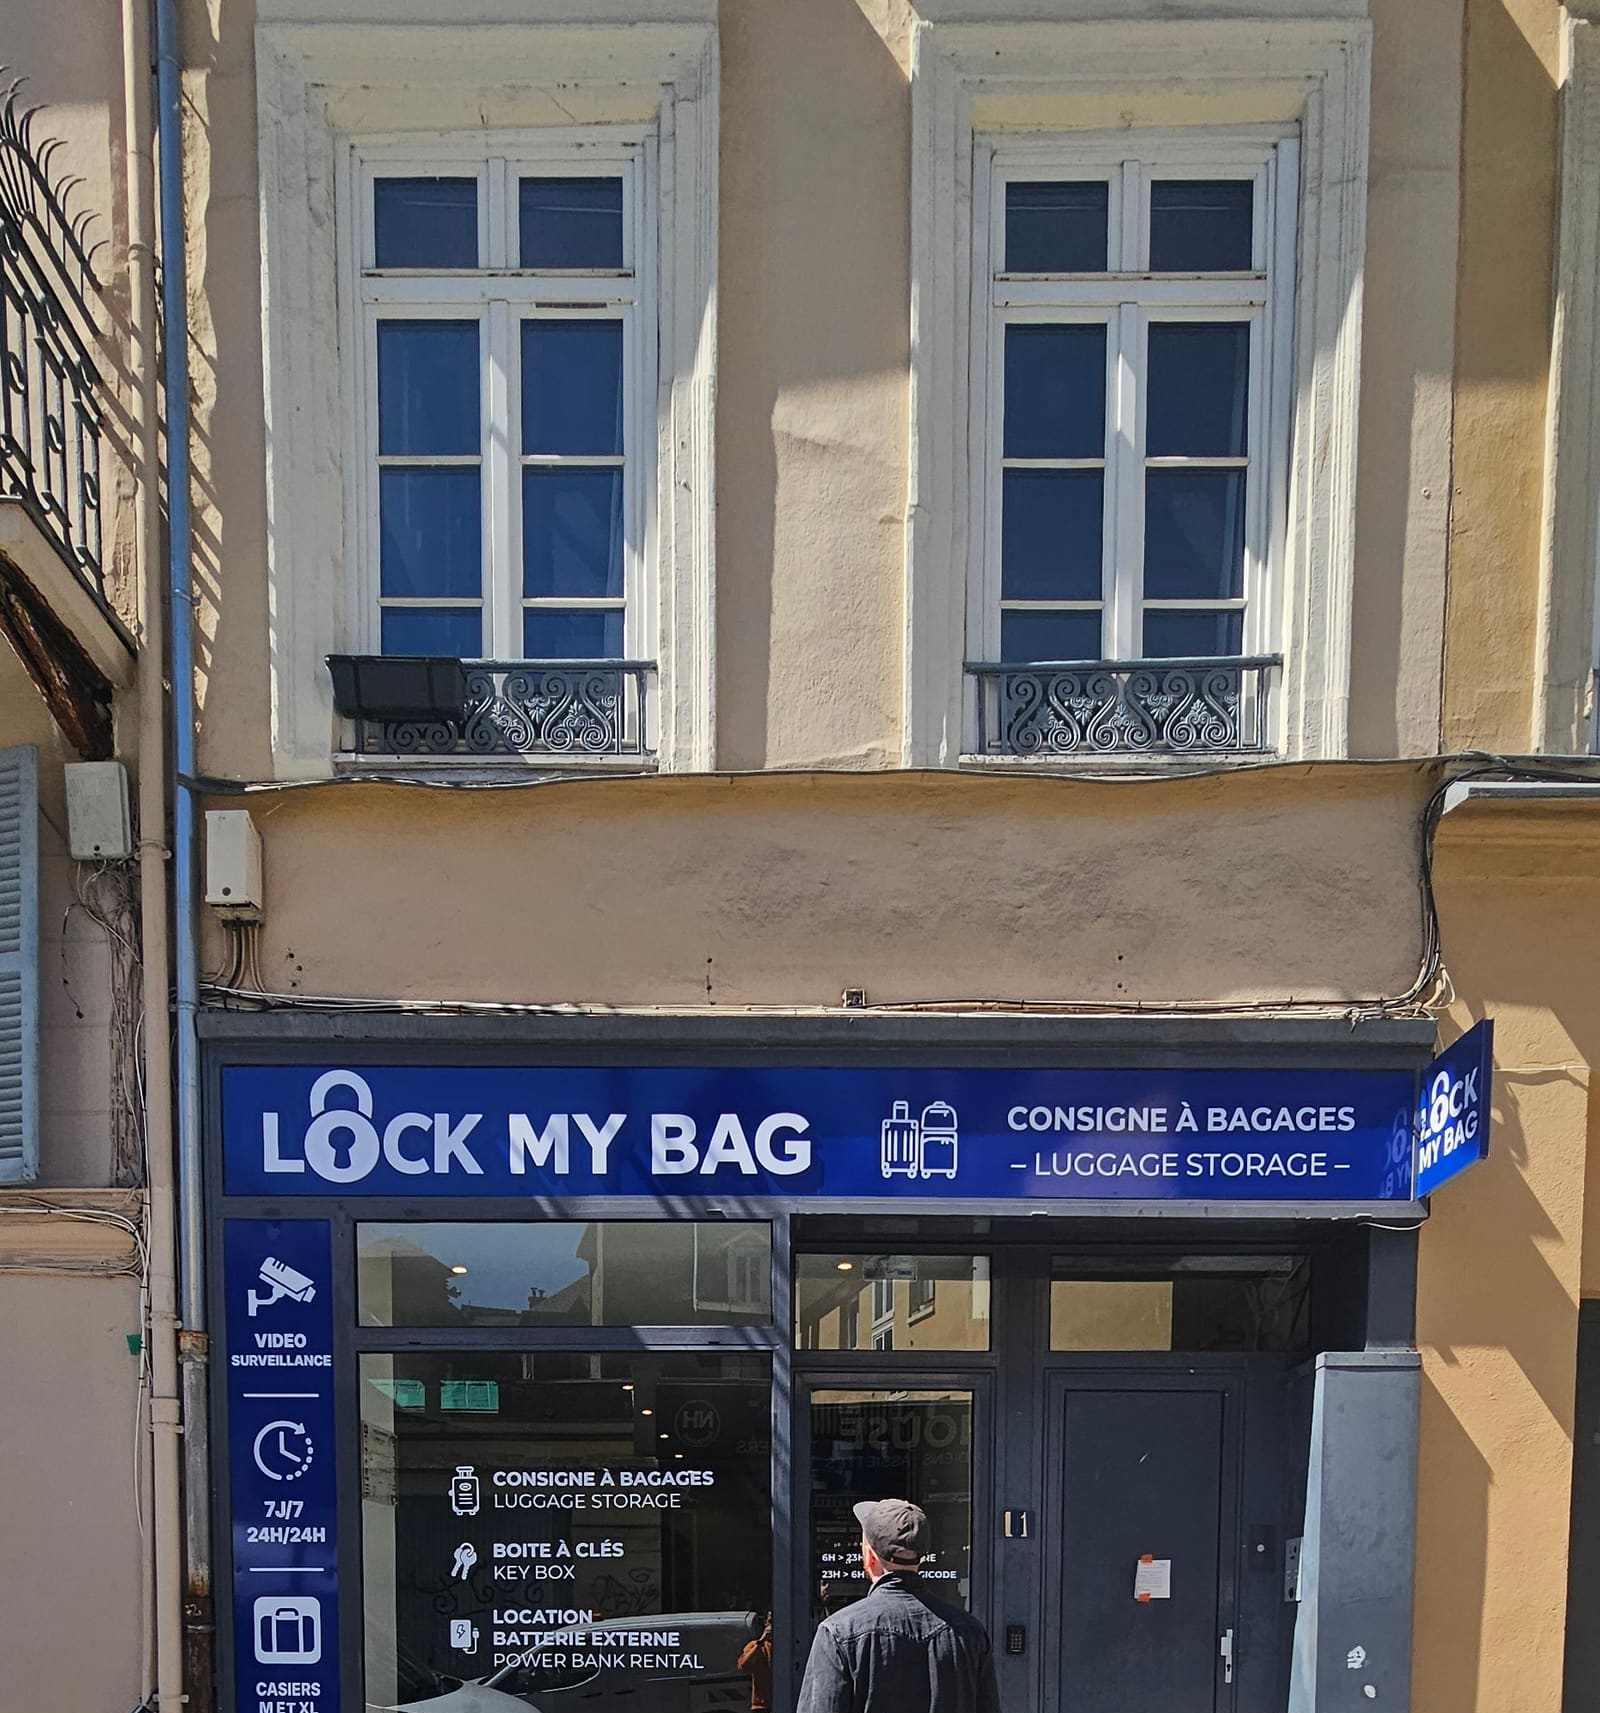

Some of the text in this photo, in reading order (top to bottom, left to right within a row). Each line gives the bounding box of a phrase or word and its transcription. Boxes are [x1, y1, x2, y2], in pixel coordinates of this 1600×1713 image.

[1420, 1066, 1478, 1142] LOCK
[1007, 1101, 1355, 1133] CONSIGNE À BAGAGES
[263, 1070, 812, 1184] LOCK MY BAG
[1418, 1110, 1478, 1174] MY BAG
[1035, 1152, 1179, 1177] LUGGAGE
[1186, 1152, 1328, 1177] STORAGE
[254, 1333, 307, 1349] VIDEO
[231, 1354, 332, 1367] SURVEILLANCE
[492, 1468, 715, 1487] CONSIGNE À BAGAGES
[494, 1493, 681, 1509] LUGGAGE STORAGE
[263, 1500, 304, 1520] 7J/7
[246, 1526, 327, 1544] 24H/24H
[493, 1538, 625, 1558] BOITE À CLÉS
[822, 1553, 836, 1562] 6H
[494, 1564, 576, 1580] KEY BOX
[821, 1570, 841, 1579] 23H
[851, 1570, 865, 1579] 6H
[493, 1609, 594, 1625] LOCATION
[493, 1631, 680, 1647] BATTERIE EXTERNE
[494, 1653, 705, 1669] POWER BANK RENTAL
[255, 1681, 321, 1697] CASIERS
